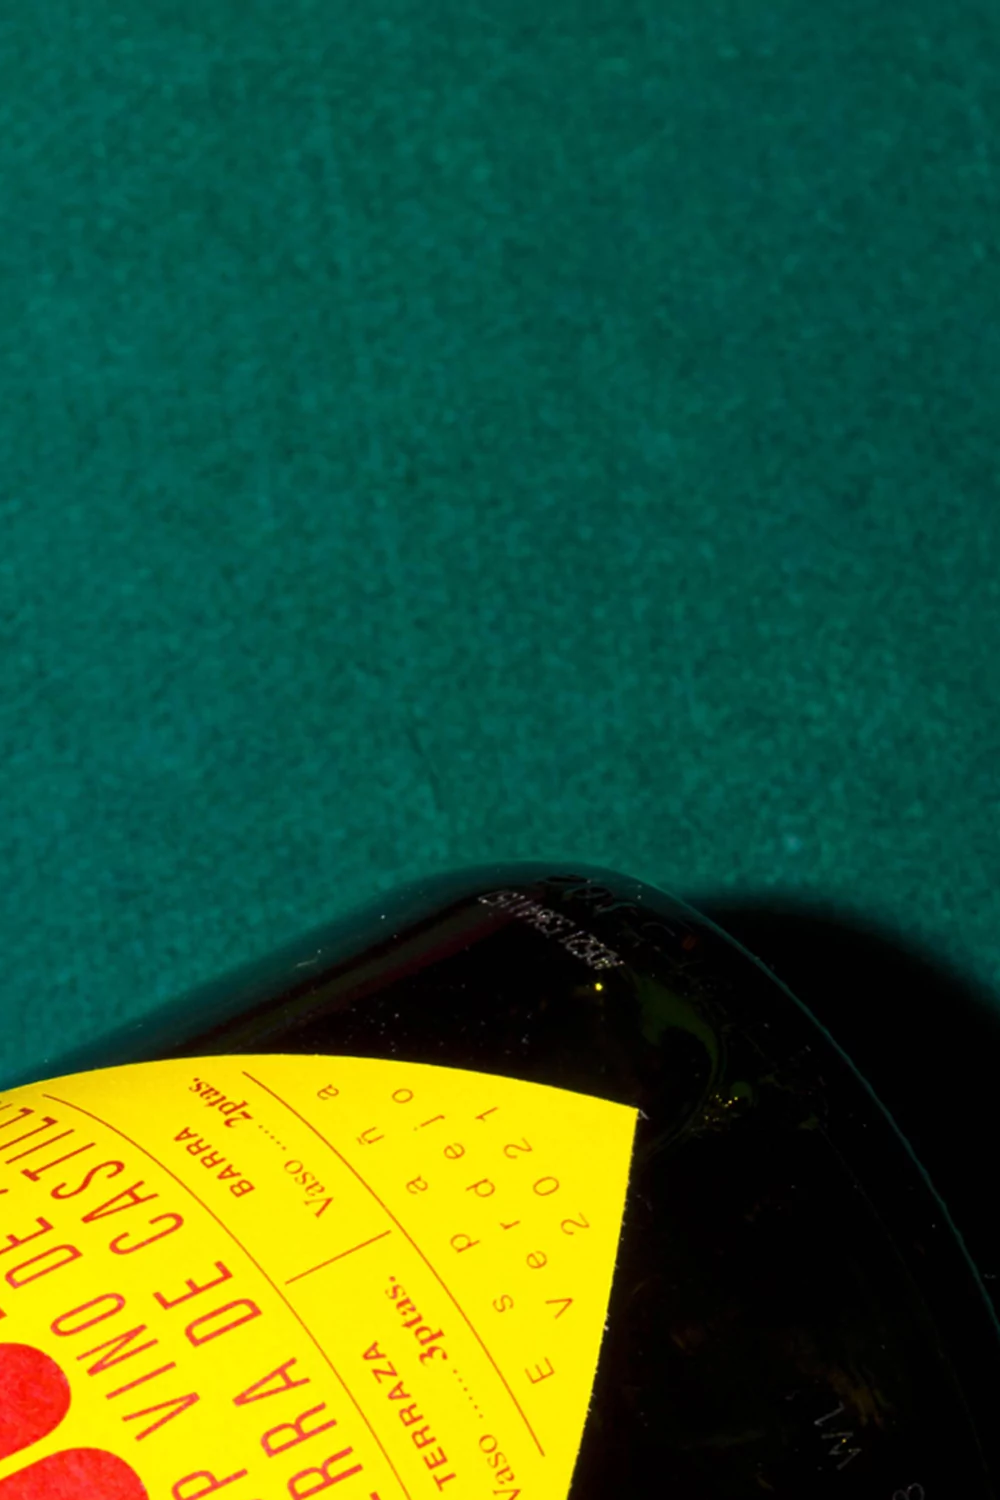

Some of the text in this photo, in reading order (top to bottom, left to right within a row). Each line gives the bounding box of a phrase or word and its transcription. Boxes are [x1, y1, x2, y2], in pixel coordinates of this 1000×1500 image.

[172, 1125, 257, 1199] BARRA
[187, 1076, 335, 1220] Vaso 2ptas.
[391, 1087, 574, 1320] Verdejo
[474, 1106, 591, 1236] 2021
[49, 1291, 201, 1443] VINO
[151, 1259, 264, 1348] DE
[384, 1274, 449, 1368] 3ptas.
[361, 1340, 457, 1493] TERRAZA
